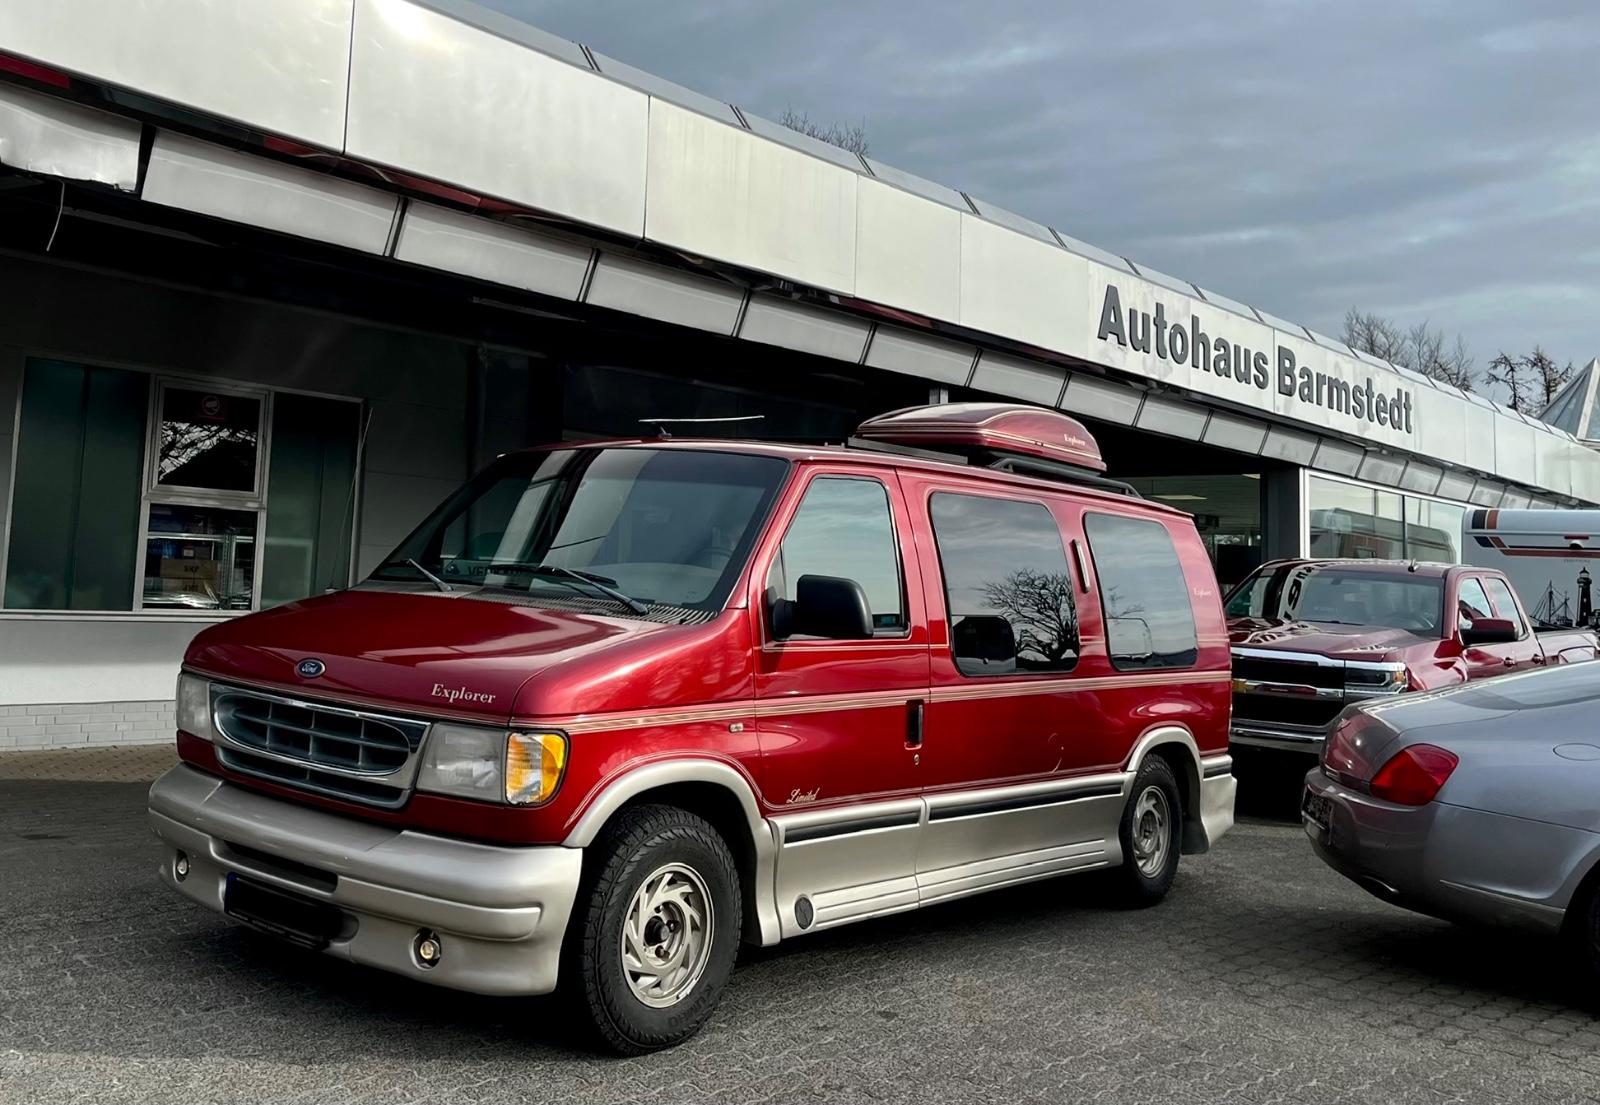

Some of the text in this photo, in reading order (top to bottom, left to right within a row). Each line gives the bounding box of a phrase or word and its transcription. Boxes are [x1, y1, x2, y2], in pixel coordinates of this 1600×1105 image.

[1097, 284, 1413, 434] Autohaus Barmstedt
[431, 683, 496, 704] Explorer
[786, 787, 820, 803] Limited
